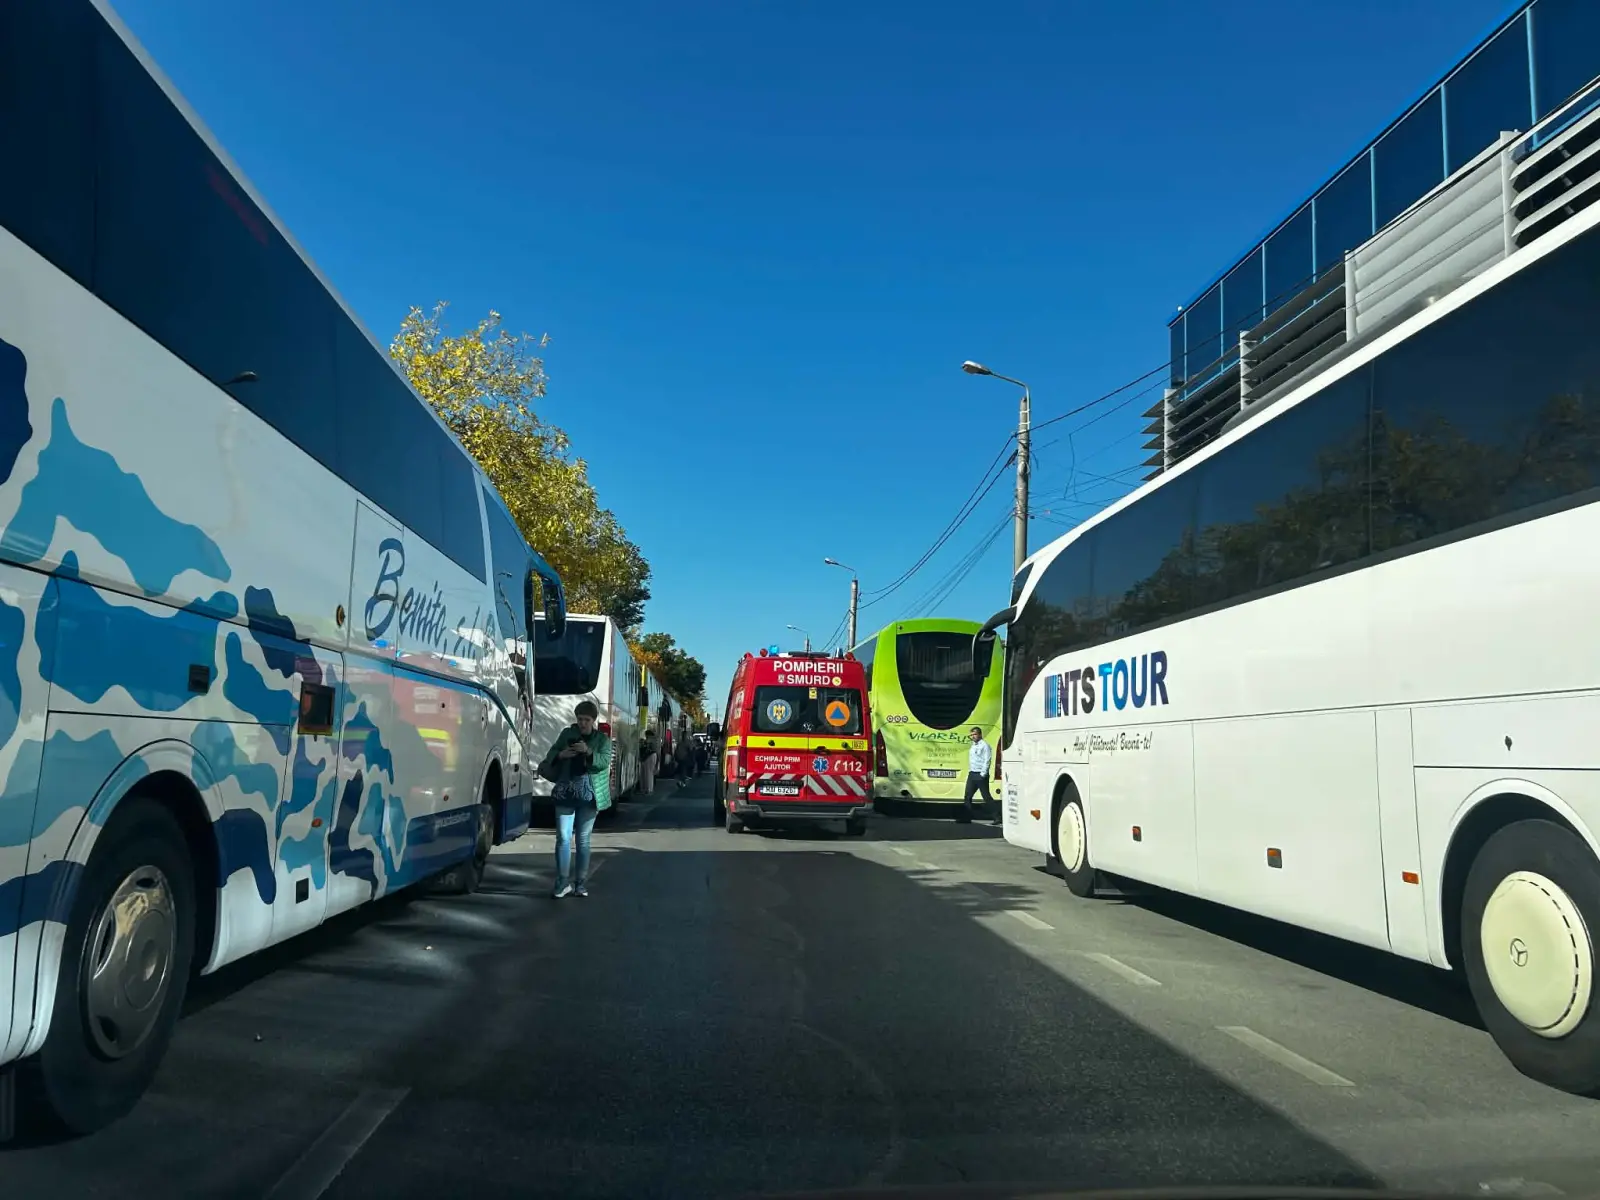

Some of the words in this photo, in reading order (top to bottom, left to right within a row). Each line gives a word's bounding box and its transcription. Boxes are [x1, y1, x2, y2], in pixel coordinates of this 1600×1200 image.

[773, 660, 844, 674] POMPIERII
[787, 674, 831, 685] SMURD
[1057, 666, 1095, 717] NTS
[1098, 650, 1169, 712] TOUR
[754, 755, 782, 763] ECHIPAJ
[842, 761, 862, 772] 112
